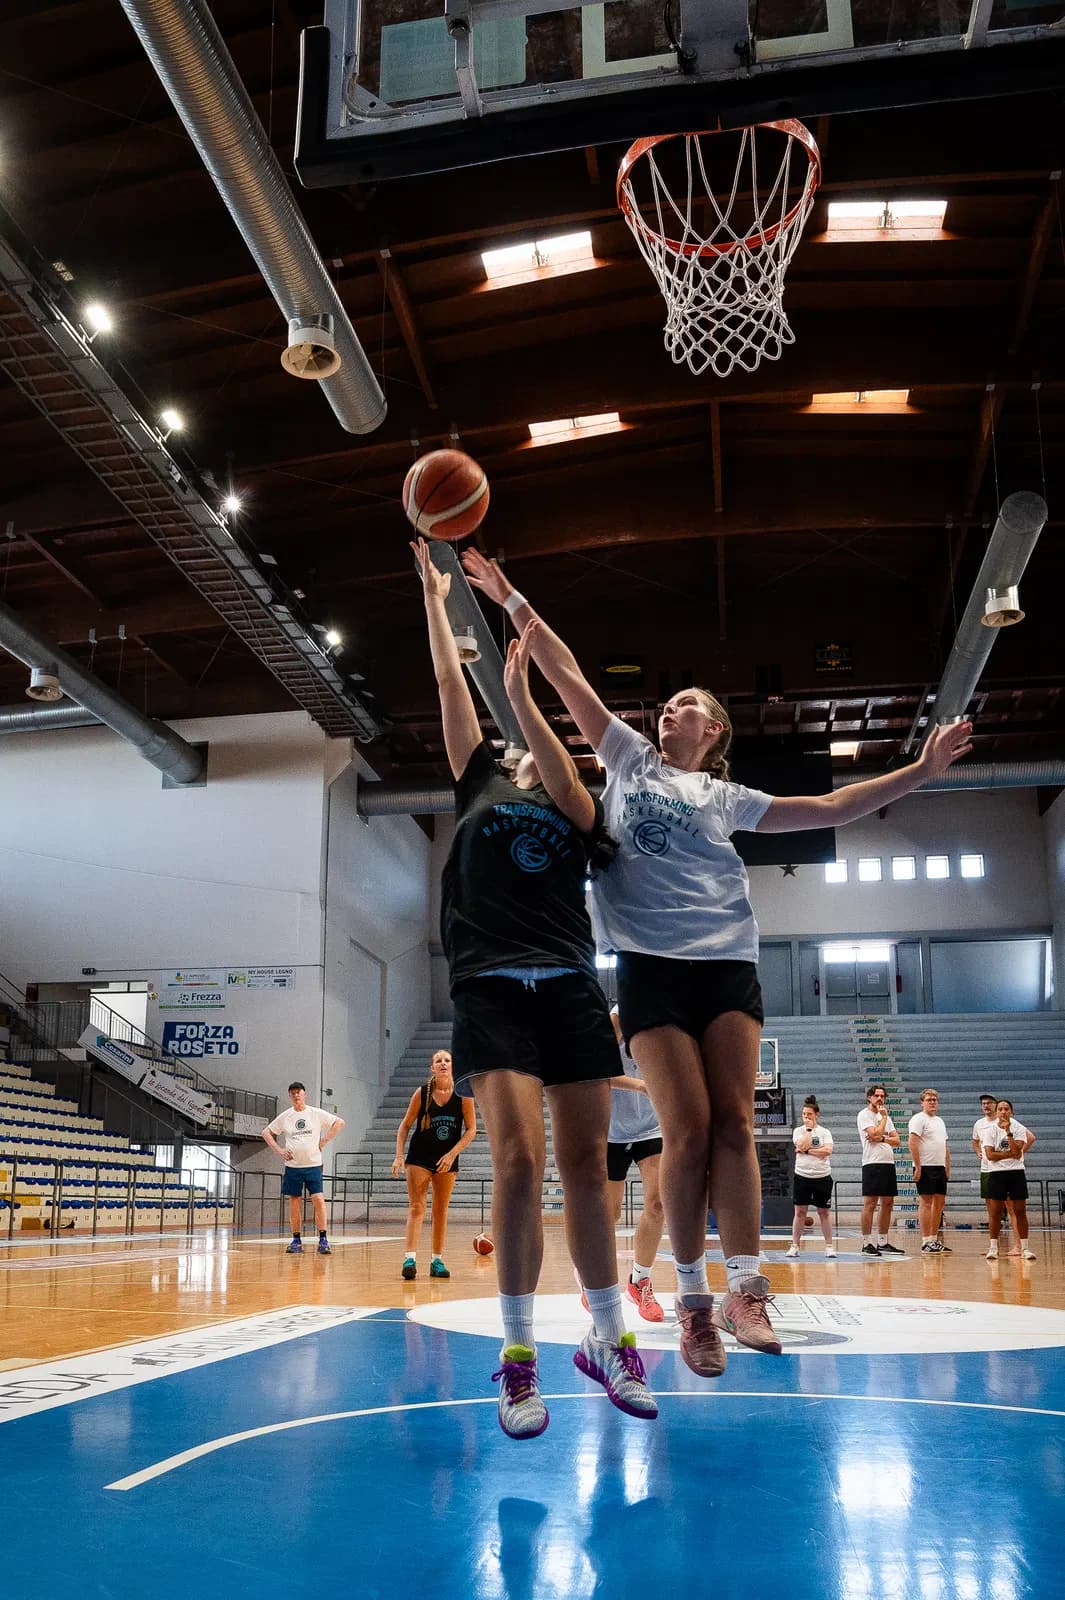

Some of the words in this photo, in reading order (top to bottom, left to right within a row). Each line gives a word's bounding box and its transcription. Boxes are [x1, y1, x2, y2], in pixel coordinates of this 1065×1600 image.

[624, 791, 696, 817] TRANSFORMING
[493, 804, 572, 836] TRANSFORMING
[482, 818, 571, 858] BASKETBALL
[191, 992, 222, 1001] Frezza
[175, 1025, 234, 1039] FORZA
[167, 1040, 239, 1055] ROSETO
[0, 1373, 134, 1409] EDA
